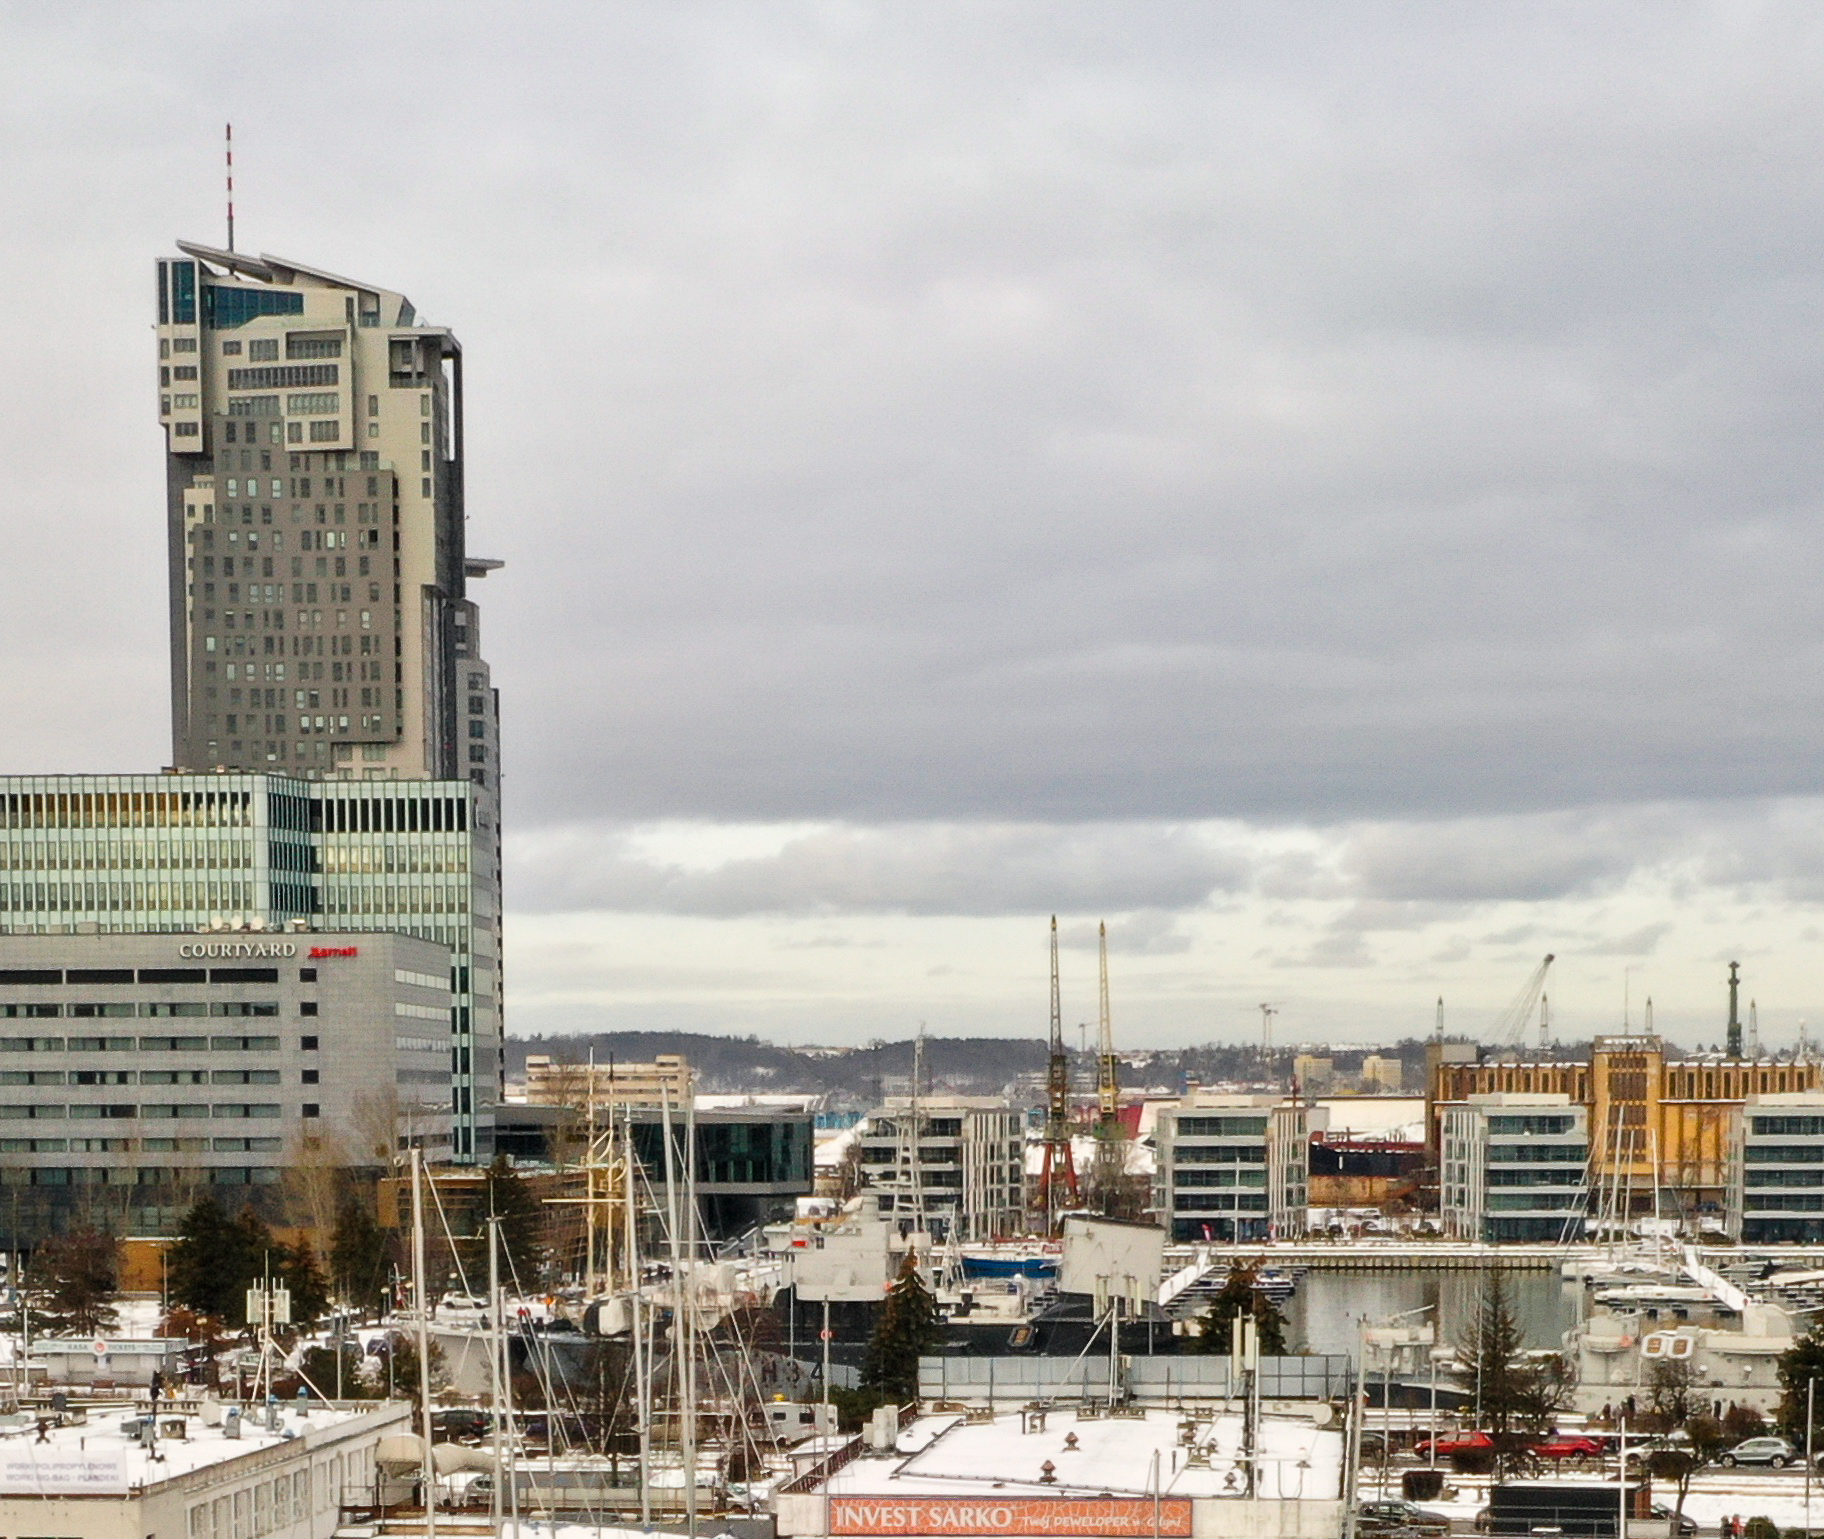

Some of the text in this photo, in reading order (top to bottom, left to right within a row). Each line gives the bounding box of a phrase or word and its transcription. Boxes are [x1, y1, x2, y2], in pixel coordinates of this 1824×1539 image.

[179, 943, 296, 958] COURTYARD
[836, 1506, 922, 1528] INVEST
[929, 1506, 1012, 1528] SARKO
[1054, 1516, 1127, 1527] DEWELOPER
